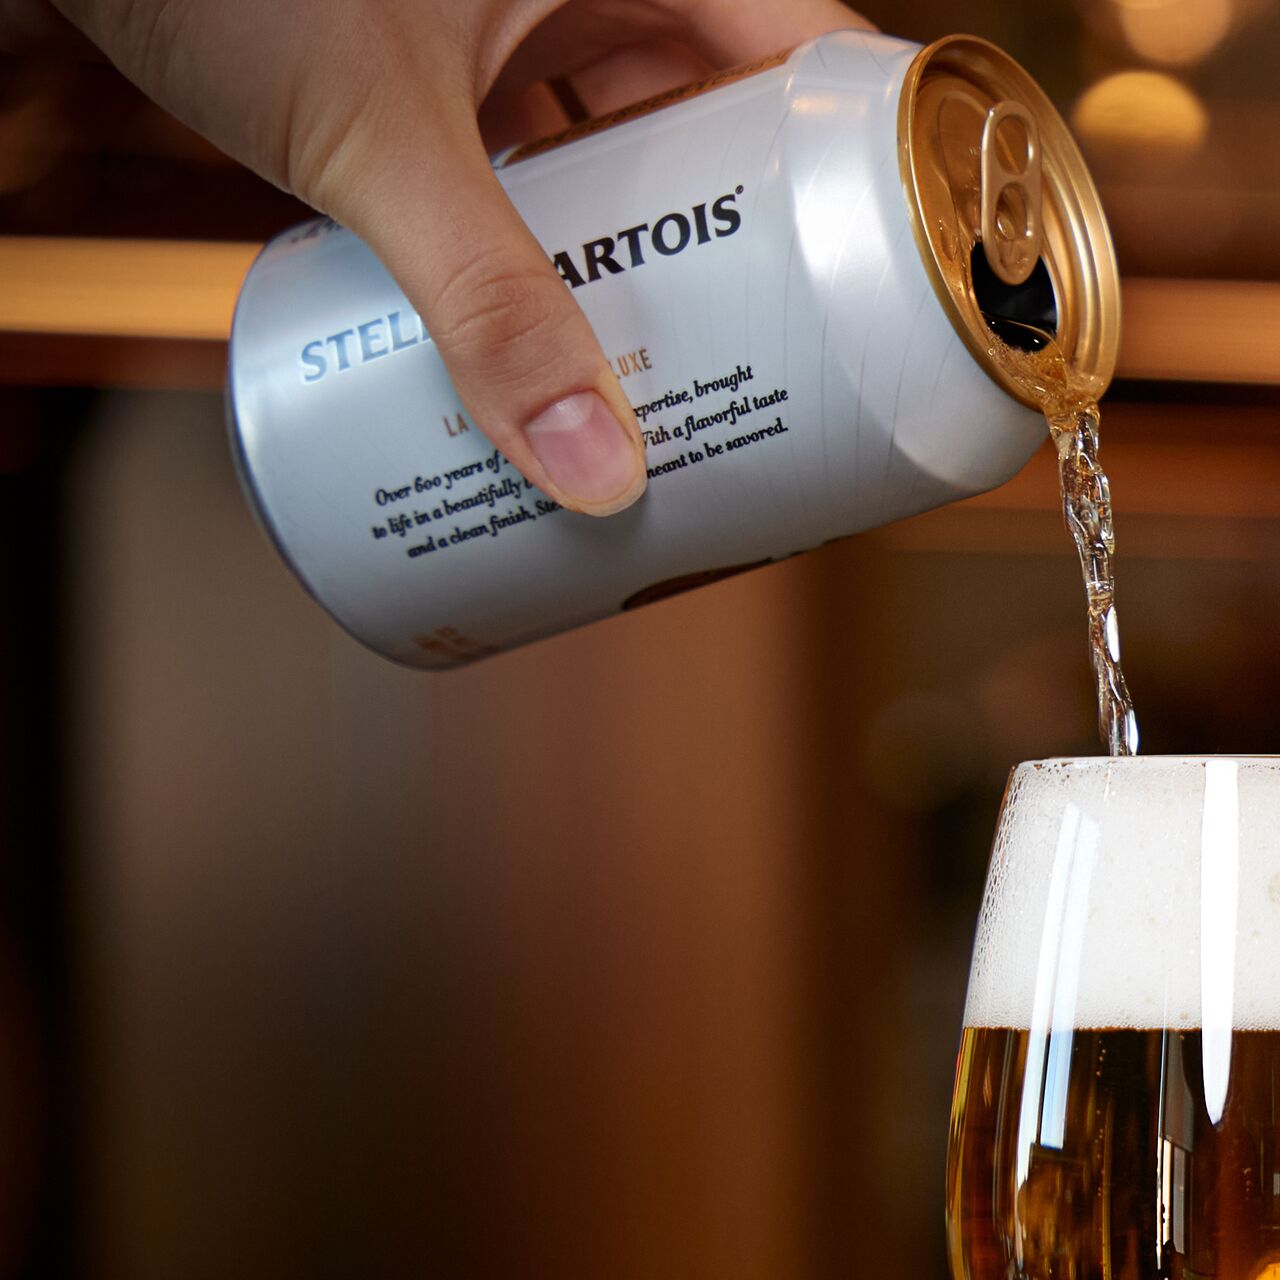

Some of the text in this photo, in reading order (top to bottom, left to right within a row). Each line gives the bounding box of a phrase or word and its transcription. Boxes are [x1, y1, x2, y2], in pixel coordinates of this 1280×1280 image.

[373, 525, 388, 540] to
[388, 513, 413, 537] life
[413, 511, 432, 526] in
[432, 508, 444, 520] a
[444, 477, 522, 509] beautifully
[673, 426, 684, 438] a
[684, 396, 753, 441] flavorful
[753, 388, 790, 410] taste
[375, 364, 754, 506] Over 600 years of xpertise, brought
[407, 536, 437, 558] and
[437, 536, 449, 549] a
[449, 523, 489, 545] clean
[488, 505, 537, 537] finish,
[688, 447, 705, 464] to
[704, 442, 725, 458] be
[725, 416, 790, 452] savored.
[444, 412, 470, 437] LA
